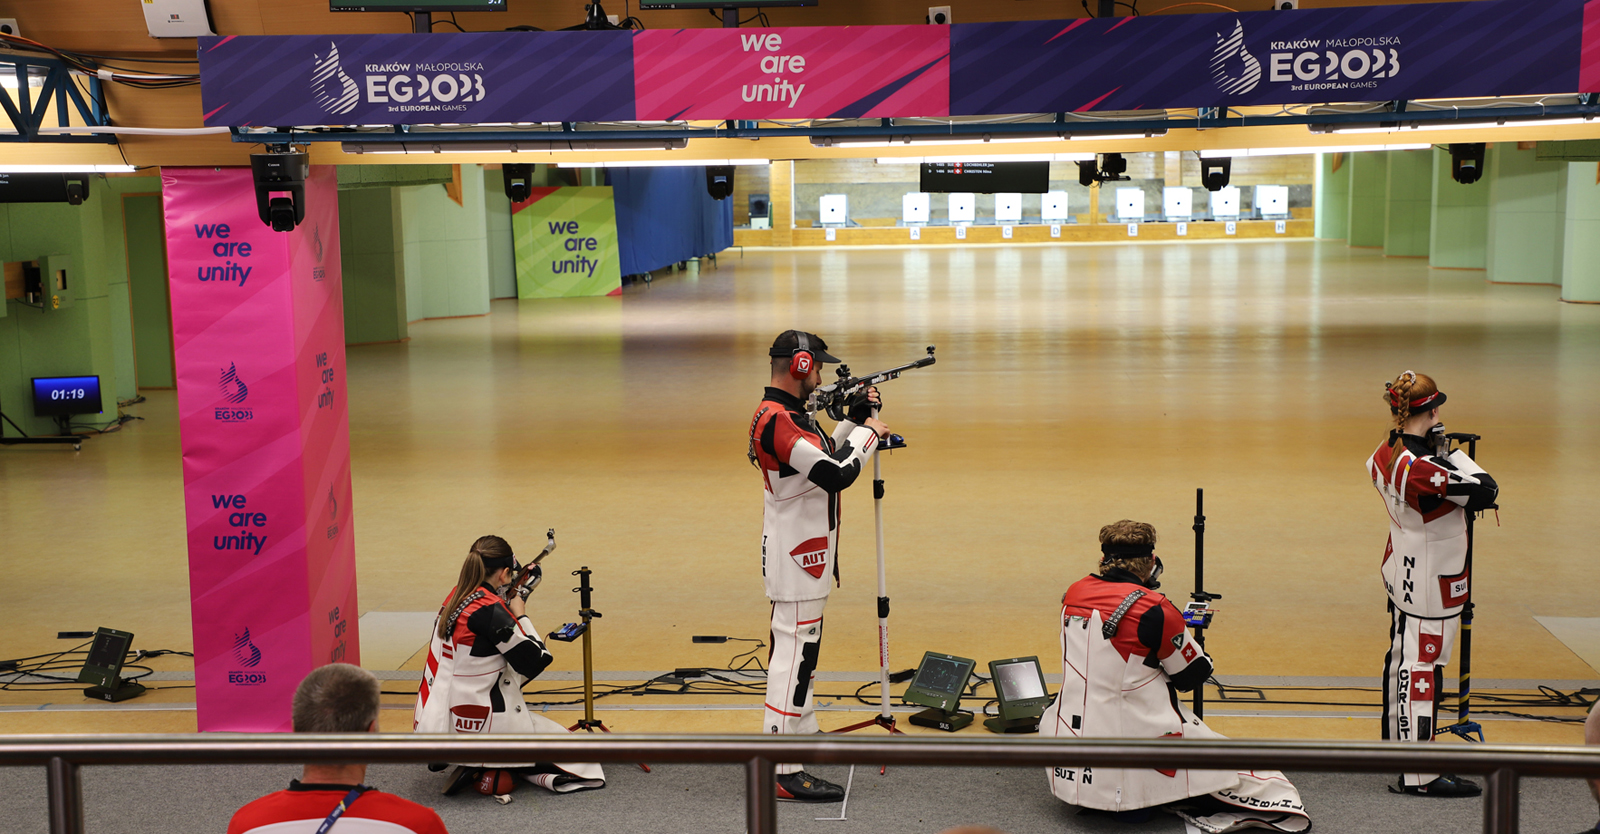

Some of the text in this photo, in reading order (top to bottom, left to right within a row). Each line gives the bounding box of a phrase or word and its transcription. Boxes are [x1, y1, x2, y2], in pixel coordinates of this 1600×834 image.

[741, 33, 782, 52] we
[1270, 36, 1401, 50] KRAKÓW MAŁOPOLSKA
[365, 61, 484, 72] KRAKÓW MAŁOPOLSKA
[760, 55, 806, 74] are
[741, 77, 806, 108] unity
[1304, 82, 1349, 91] EUROPEAN
[1350, 81, 1378, 89] GAMES
[194, 223, 231, 239] we
[548, 221, 579, 235] we
[213, 242, 252, 257] are
[564, 237, 598, 252] are
[197, 260, 252, 287] unity
[552, 254, 599, 278] unity
[316, 352, 327, 368] we
[322, 368, 334, 384] are
[51, 388, 85, 400] 01:19
[318, 386, 334, 410] unity
[211, 494, 247, 509] we
[228, 512, 267, 527] are
[213, 530, 267, 555] unity
[803, 551, 826, 566] AUT
[1402, 555, 1416, 605] NINA
[328, 606, 340, 625] we
[334, 619, 346, 639] are
[330, 639, 346, 664] unity
[1398, 669, 1410, 742] CHRIST
[455, 718, 483, 731] AUT
[1054, 766, 1076, 782] SUI
